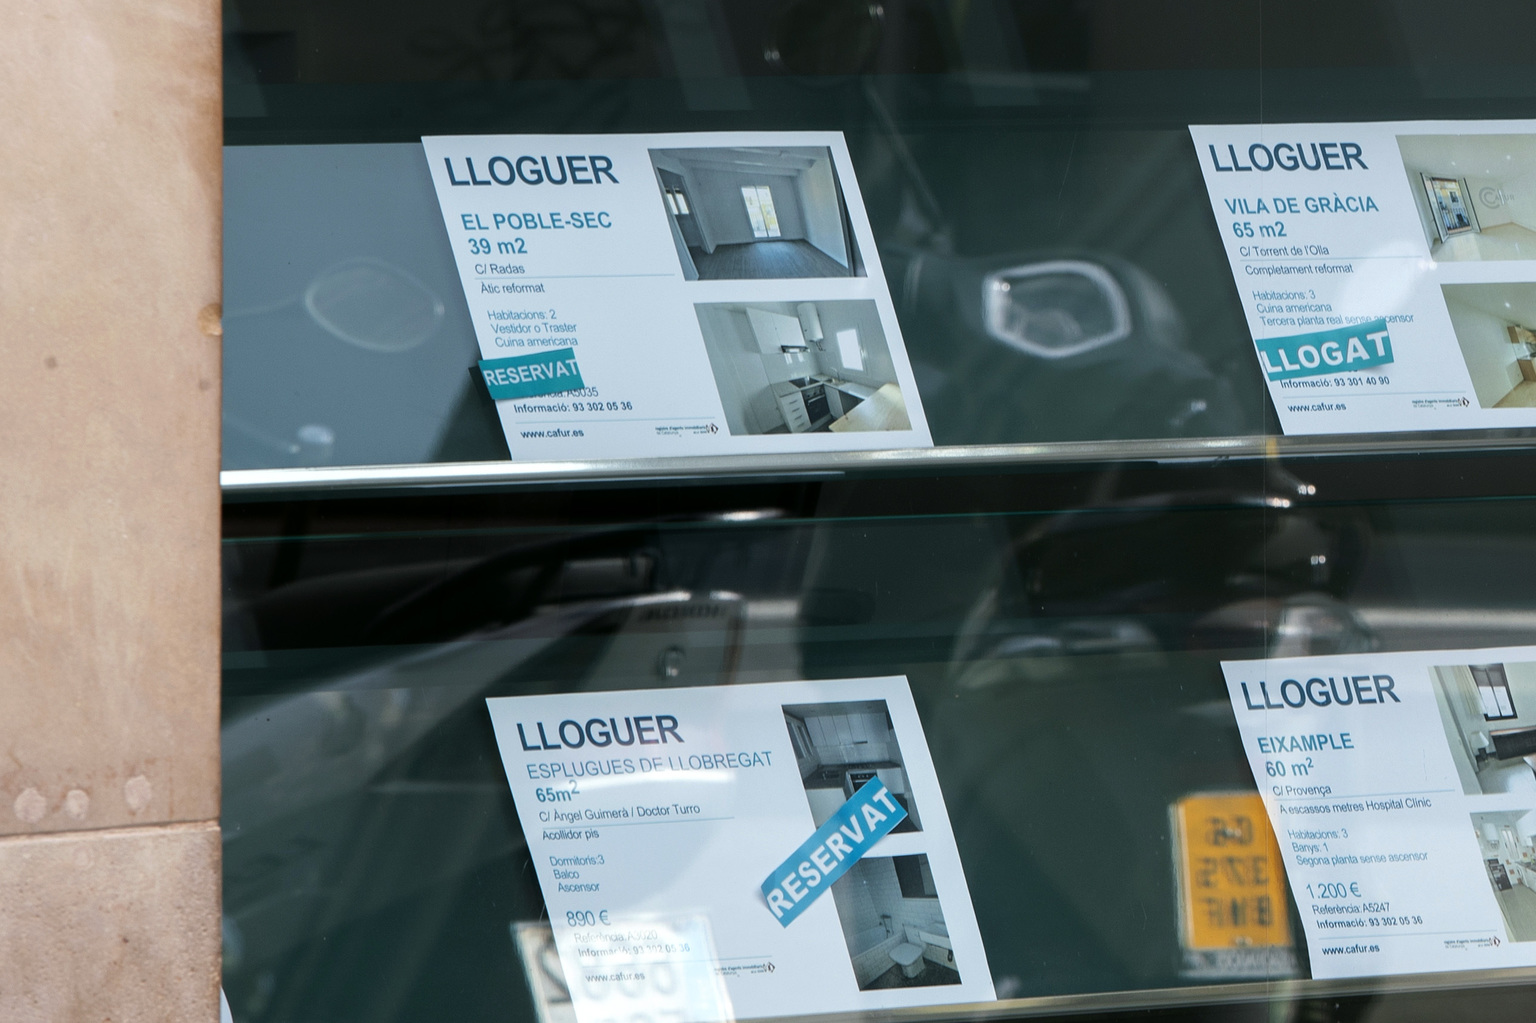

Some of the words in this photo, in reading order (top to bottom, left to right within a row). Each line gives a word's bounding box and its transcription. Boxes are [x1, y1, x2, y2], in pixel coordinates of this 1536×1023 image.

[1209, 142, 1368, 172] LLOGUER
[444, 155, 620, 186] LLOGUER
[1225, 198, 1270, 215] VILA
[1273, 197, 1300, 214] DE
[1304, 192, 1379, 213] GRÀCIA
[461, 213, 489, 230] EL
[493, 211, 612, 230] POBLE-SEC
[1232, 221, 1255, 238] 65
[1259, 221, 1287, 237] m2
[468, 238, 491, 254] 39
[497, 237, 527, 254] m2
[1240, 246, 1251, 258] C/
[1253, 246, 1288, 257] Torrent
[1290, 245, 1302, 257] de
[475, 264, 487, 274] C/
[490, 263, 525, 274] Radas
[1245, 264, 1313, 277] Completament
[1315, 263, 1353, 274] reformat
[481, 282, 500, 293] Àtic
[502, 283, 545, 293] reformat
[1260, 331, 1388, 374] LLOGAT
[483, 359, 578, 386] RESERVAT
[1288, 402, 1346, 412] www.cafur.es
[520, 428, 584, 438] www.cafur.es
[1241, 675, 1401, 711] LLOGUER
[517, 714, 685, 752] LLOGUER
[1258, 732, 1354, 754] EIXAMPLE
[527, 759, 635, 779] ESPLUGUES
[640, 757, 663, 772] DE
[669, 751, 772, 771] LLOBREGAT
[1265, 760, 1286, 777] 60
[1273, 786, 1283, 796] C/
[1286, 785, 1332, 797] Provença
[539, 811, 550, 822] C/
[554, 809, 582, 823] Àngel
[584, 808, 629, 820] Guimerà
[636, 805, 670, 817] Doctor
[672, 804, 700, 815] Turro
[1280, 804, 1288, 814] A
[1288, 802, 1331, 814] escassos
[1332, 801, 1364, 812] metres
[1366, 799, 1403, 811] Hospital
[542, 829, 583, 840] Acollidor
[585, 828, 599, 841] pis
[766, 786, 897, 918] RESERVAT
[1306, 882, 1347, 899] 1.200
[1350, 882, 1361, 897] €
[566, 910, 595, 927] 890
[599, 910, 611, 926] €
[1322, 944, 1380, 955] www.cafur.es
[585, 972, 645, 982] www.cafur.es
